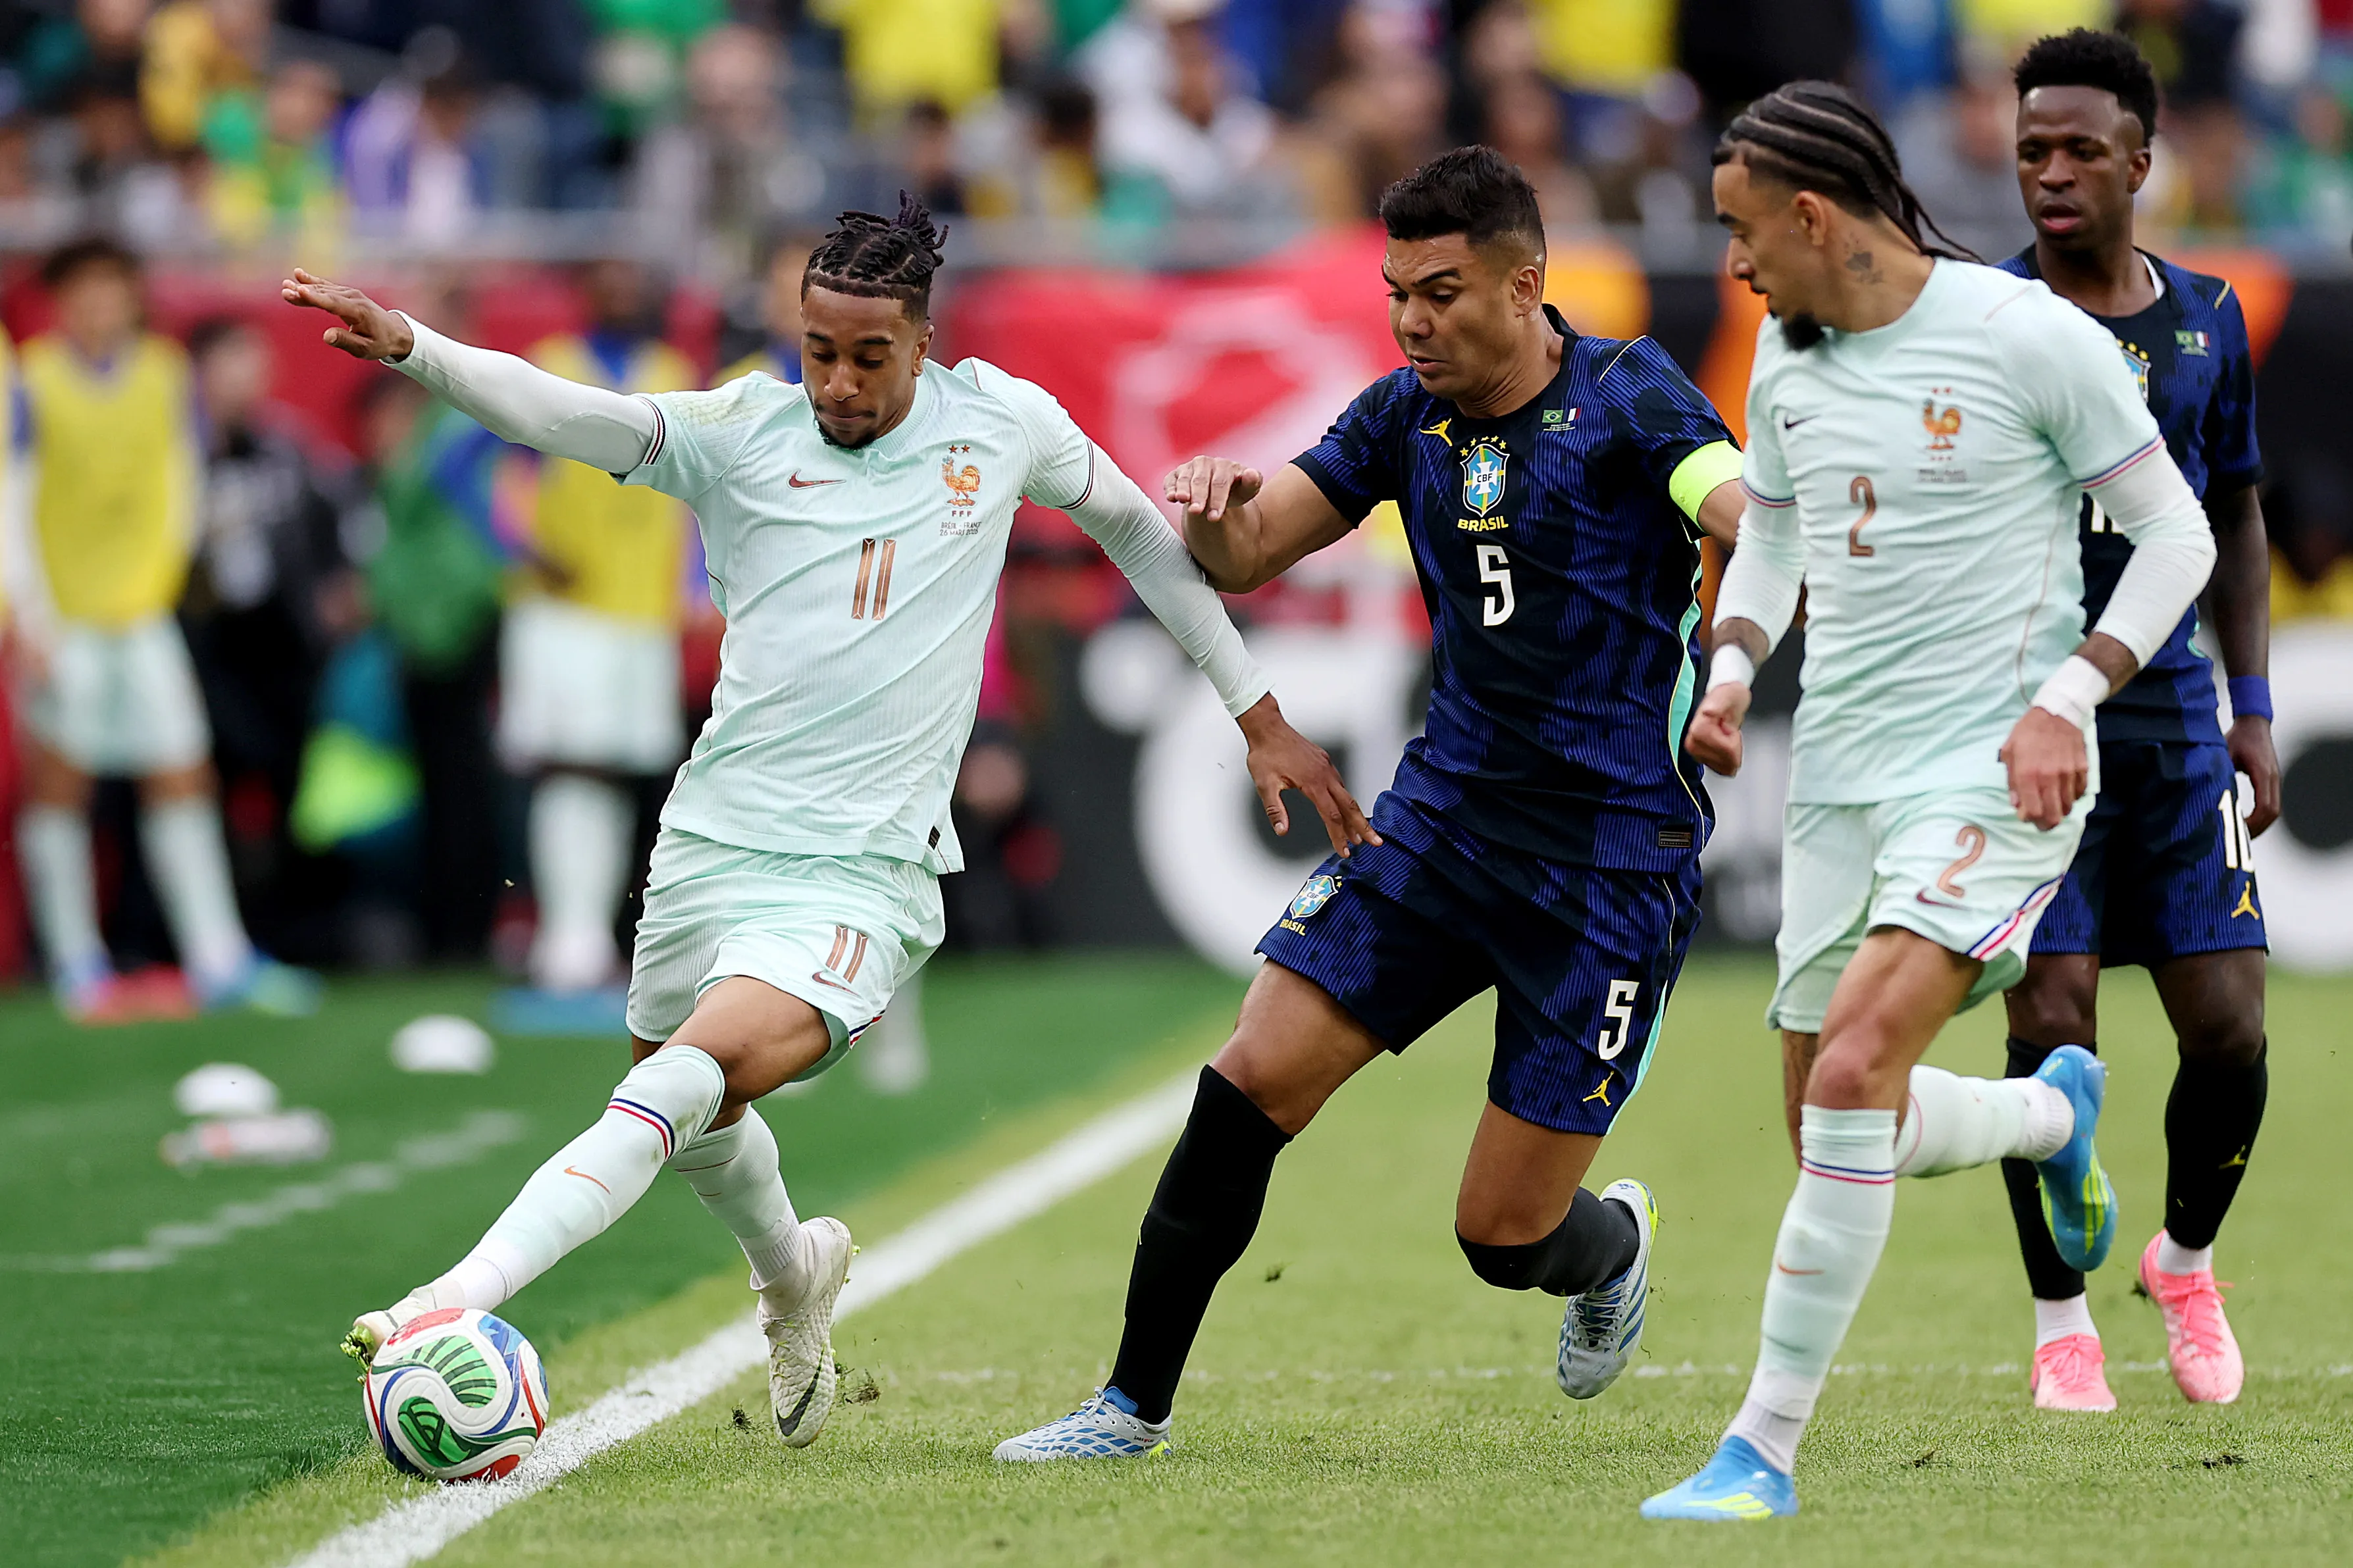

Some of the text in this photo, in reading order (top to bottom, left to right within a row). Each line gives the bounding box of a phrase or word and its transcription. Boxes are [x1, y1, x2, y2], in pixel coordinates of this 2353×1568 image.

[1476, 472, 1493, 484] CBF
[1457, 515, 1509, 532] BRASIL
[1849, 476, 1877, 557] 2
[851, 538, 896, 620] 11
[1476, 544, 1514, 626] 5
[1937, 826, 1986, 899] 2
[825, 924, 869, 984] 11
[1279, 919, 1306, 936] BRASIL
[1598, 979, 1640, 1060] 5
